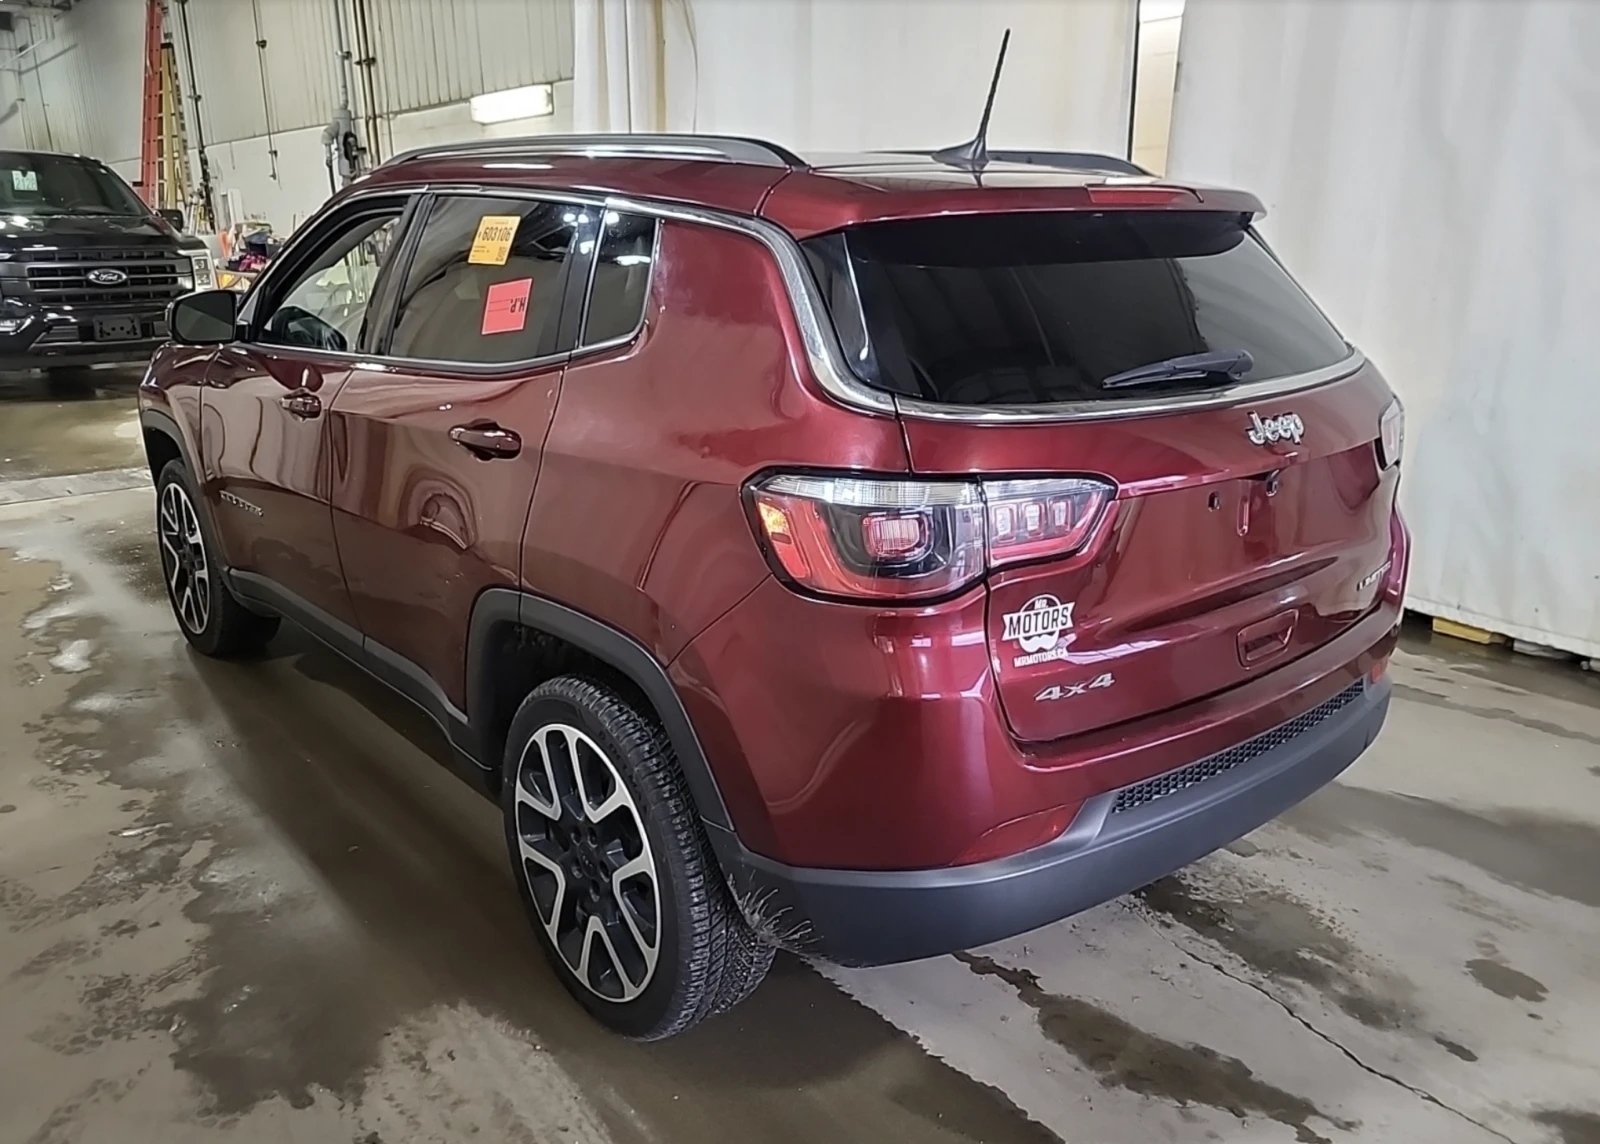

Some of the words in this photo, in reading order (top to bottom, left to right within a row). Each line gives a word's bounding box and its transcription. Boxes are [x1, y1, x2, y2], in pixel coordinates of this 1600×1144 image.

[482, 226, 512, 242] 603106
[98, 273, 118, 281] Ford
[1247, 410, 1304, 445] Jeep
[1034, 599, 1049, 609] MR.
[1008, 606, 1069, 637] MOTORS
